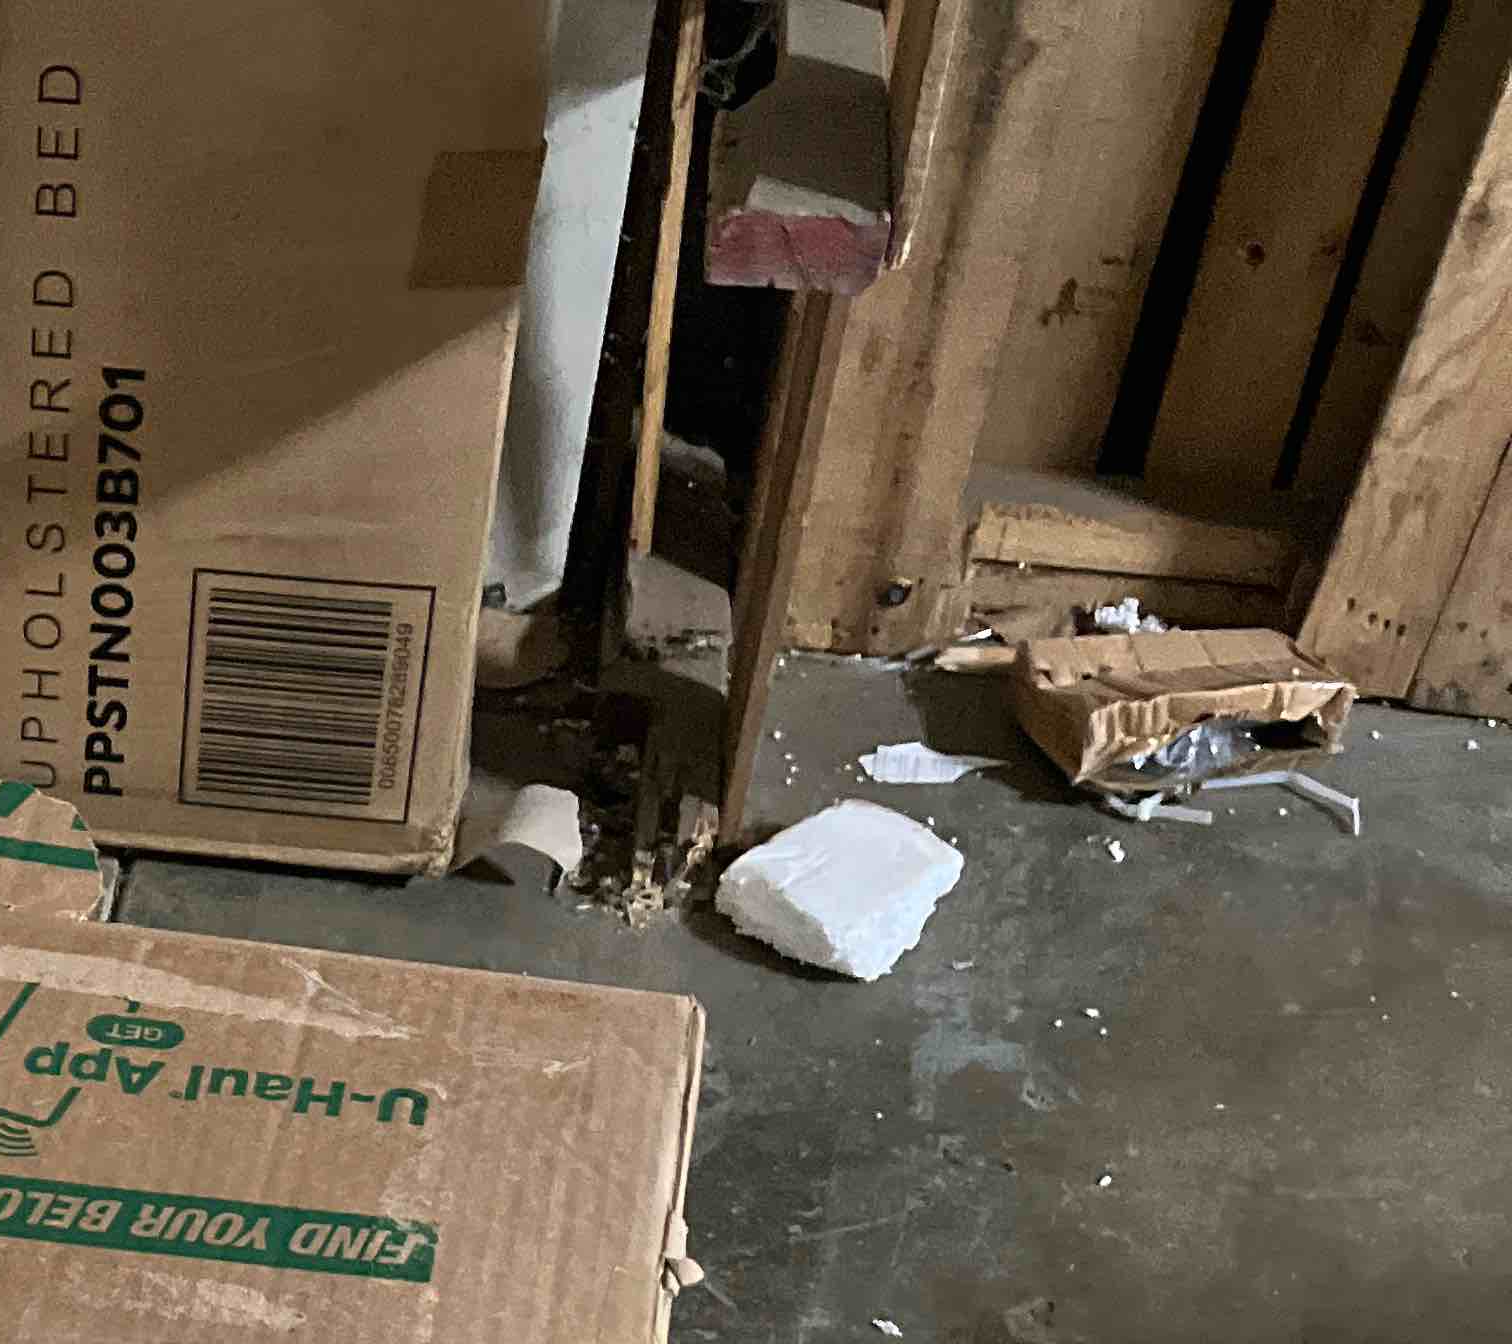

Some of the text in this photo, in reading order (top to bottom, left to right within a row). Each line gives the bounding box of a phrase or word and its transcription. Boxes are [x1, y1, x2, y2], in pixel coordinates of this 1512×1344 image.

[19, 64, 83, 790] UPHOLSTERED BED
[83, 364, 147, 797] PPSTN003B701
[104, 1020, 166, 1042] GET
[23, 1040, 167, 1097] App
[129, 1203, 273, 1252] YOUR
[289, 1221, 426, 1266] FIND
